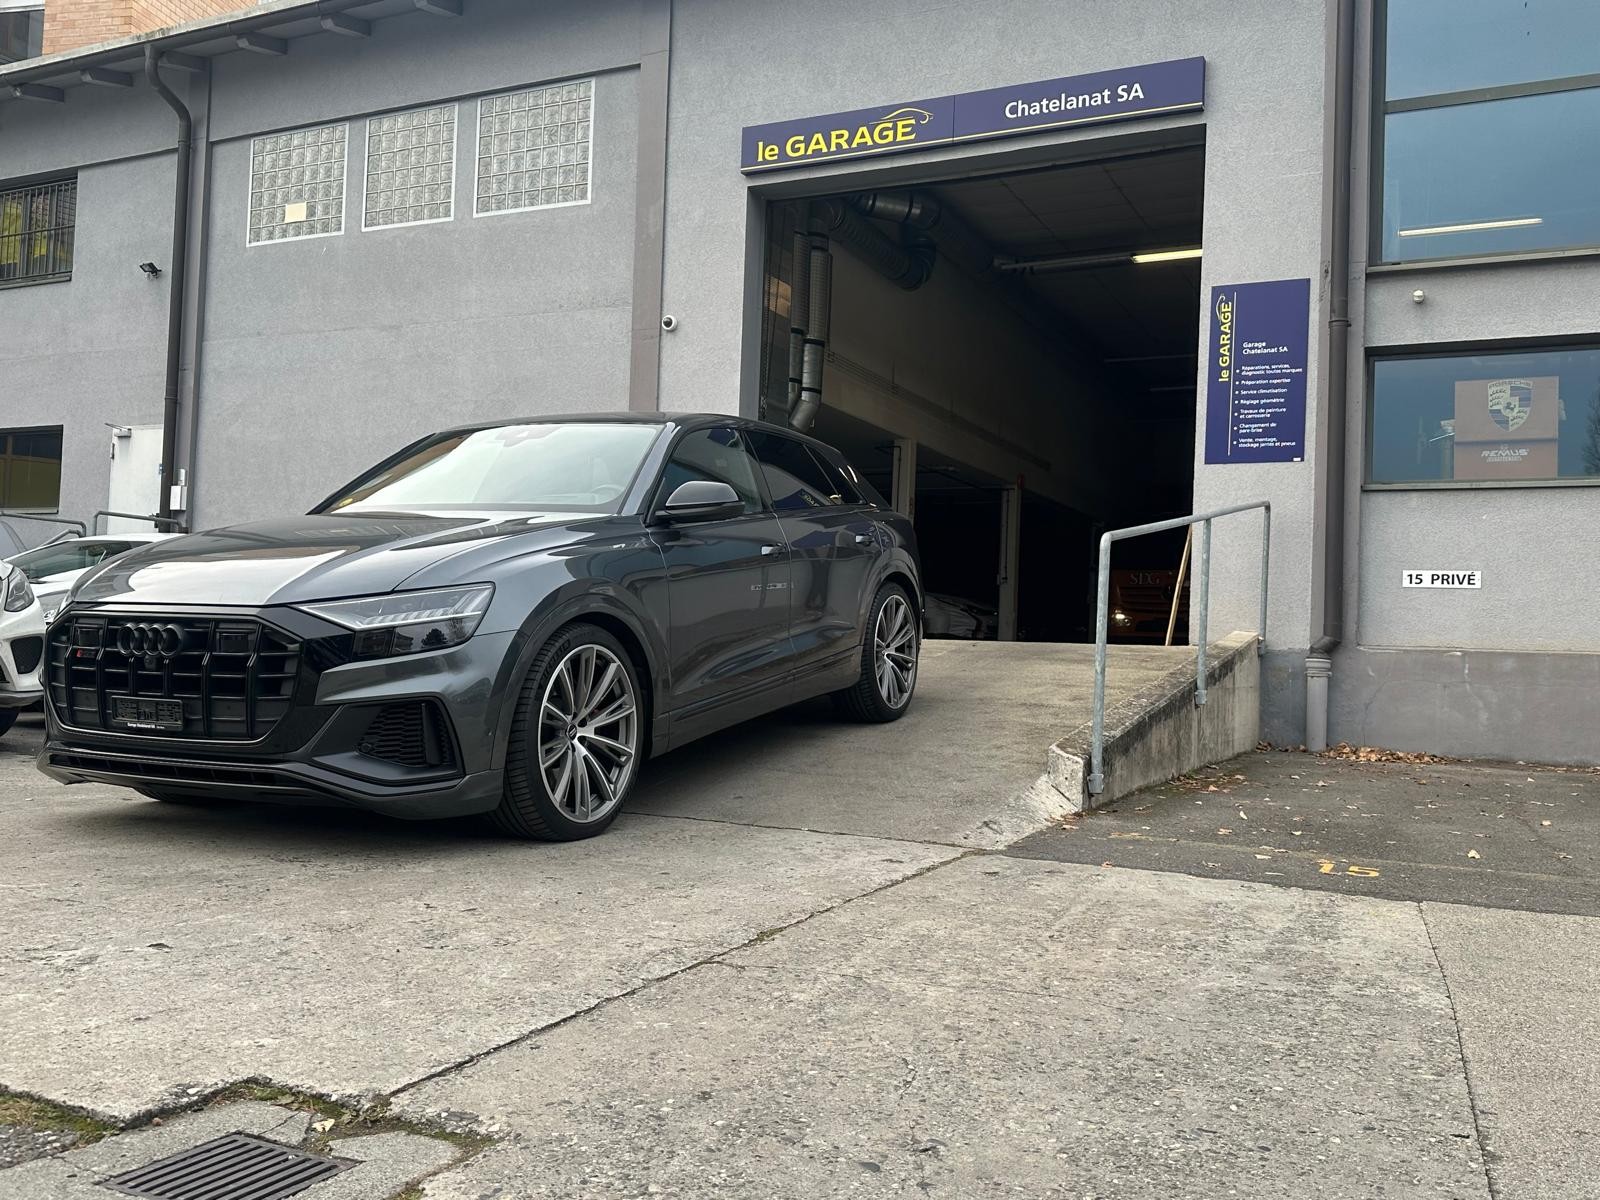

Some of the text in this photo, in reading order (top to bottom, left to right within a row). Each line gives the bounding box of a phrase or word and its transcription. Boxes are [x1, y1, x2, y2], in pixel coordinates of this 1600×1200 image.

[1004, 82, 1145, 119] Chatelanat SA
[757, 117, 917, 162] le GARAGE
[1218, 301, 1232, 382] le GARAGE
[1242, 341, 1266, 349] Garage
[1242, 347, 1278, 355] Chatelanat
[1257, 387, 1288, 395] climatisation
[1480, 447, 1529, 457] REMUS
[1406, 571, 1476, 586] 15 PRIVÉ
[1318, 862, 1381, 878] 15
